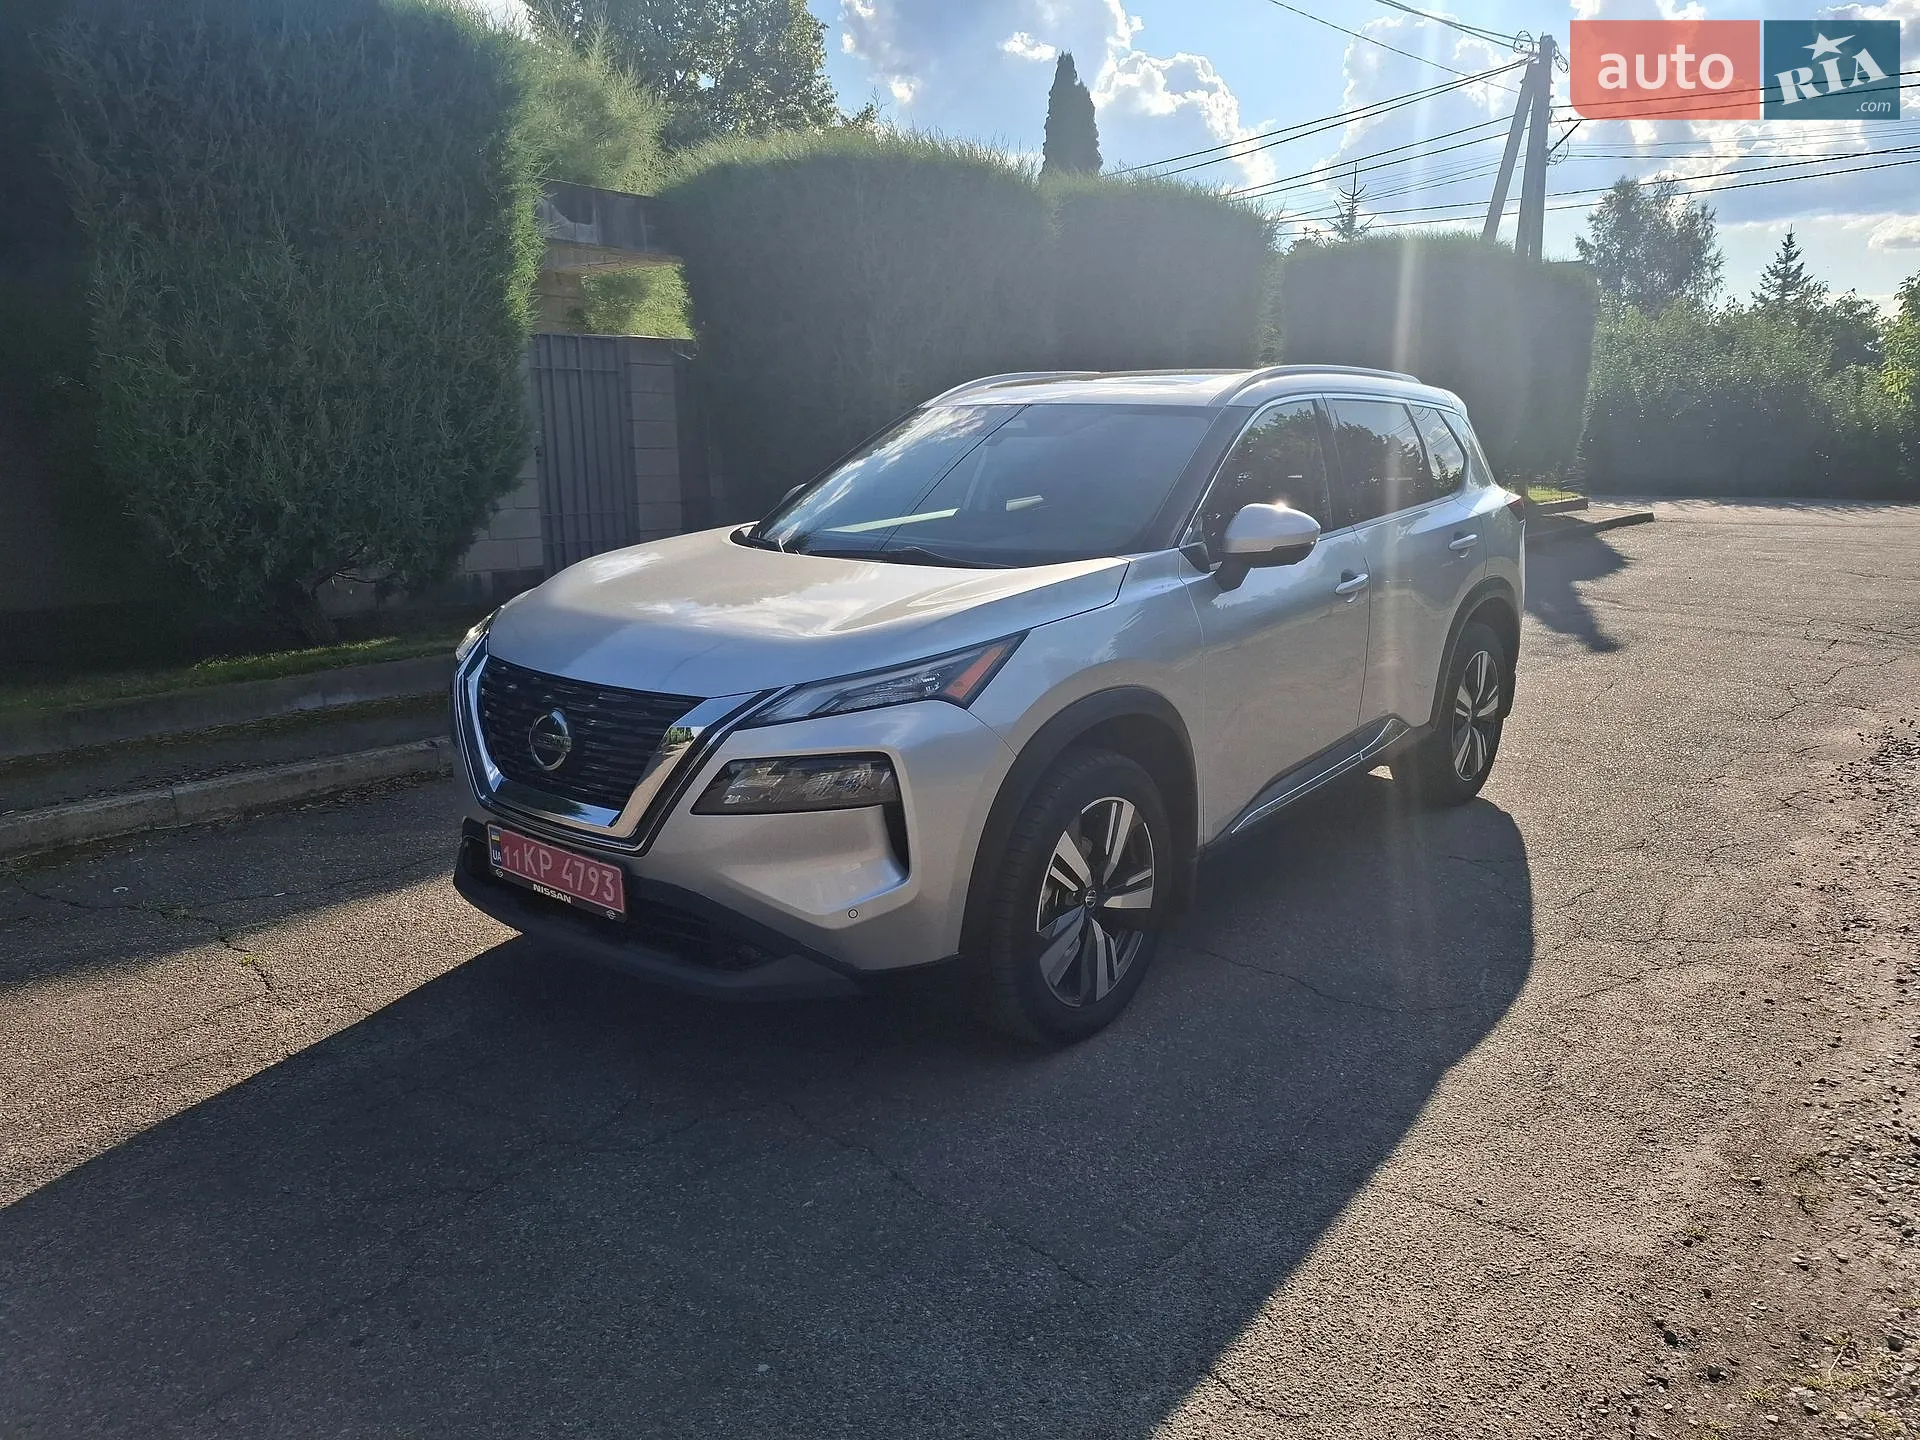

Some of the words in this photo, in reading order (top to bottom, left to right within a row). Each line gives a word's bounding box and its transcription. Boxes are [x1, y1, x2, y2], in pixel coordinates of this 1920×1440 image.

[491, 850, 502, 862] UA
[561, 858, 615, 902] 4793
[533, 883, 572, 904] NISSAN
